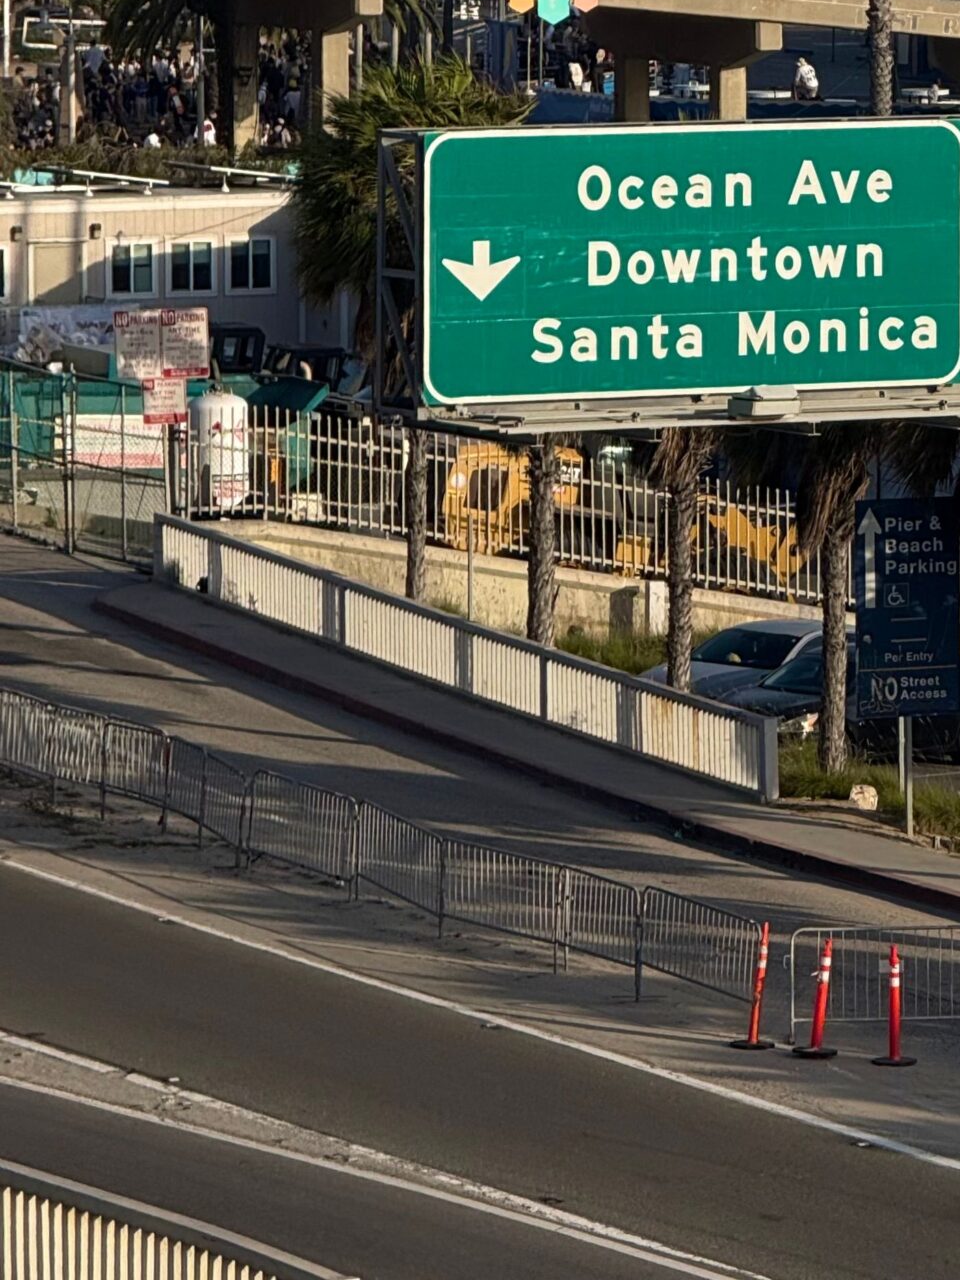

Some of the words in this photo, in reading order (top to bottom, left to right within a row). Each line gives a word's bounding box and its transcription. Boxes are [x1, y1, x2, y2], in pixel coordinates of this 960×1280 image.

[577, 165, 752, 211] Ocean
[788, 159, 893, 205] Ave
[587, 236, 883, 286] Downtown
[115, 312, 128, 327] NO
[129, 315, 158, 326] PARKING
[162, 310, 175, 325] NO
[176, 313, 205, 323] PARKING
[531, 314, 703, 363] Santa
[738, 310, 937, 356] Monica
[884, 517, 922, 532] Pier
[929, 515, 942, 530] &
[885, 537, 944, 554] Beach
[885, 558, 957, 575] Parking
[884, 652, 903, 663] Per
[906, 651, 934, 663] Entry
[871, 676, 898, 701] NO
[900, 676, 940, 687] Street
[900, 690, 948, 700] Access
